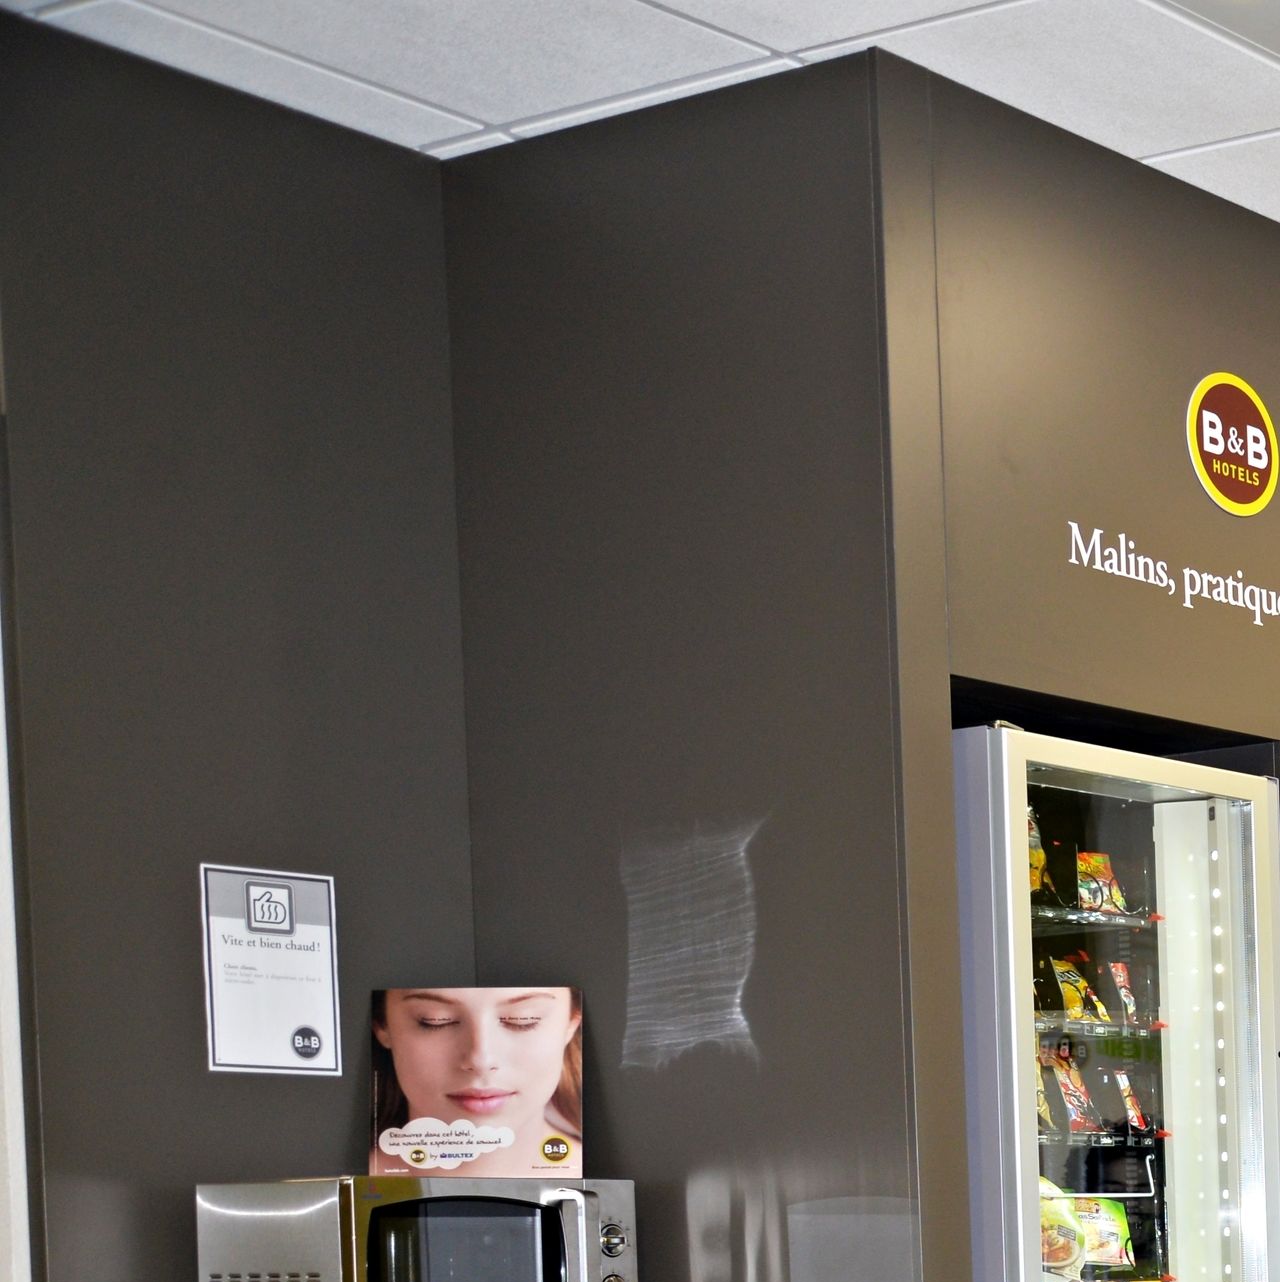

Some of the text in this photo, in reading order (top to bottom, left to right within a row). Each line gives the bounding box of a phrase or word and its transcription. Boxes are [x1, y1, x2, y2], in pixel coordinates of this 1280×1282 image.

[1202, 409, 1269, 470] B&B
[1212, 458, 1260, 486] HOTELS
[1067, 520, 1176, 596] Malins,
[221, 934, 244, 948] Vite
[246, 936, 257, 949] et
[259, 936, 282, 950] bien
[294, 1035, 320, 1048] B&B
[429, 1152, 438, 1161] by
[544, 1144, 568, 1154] B&B
